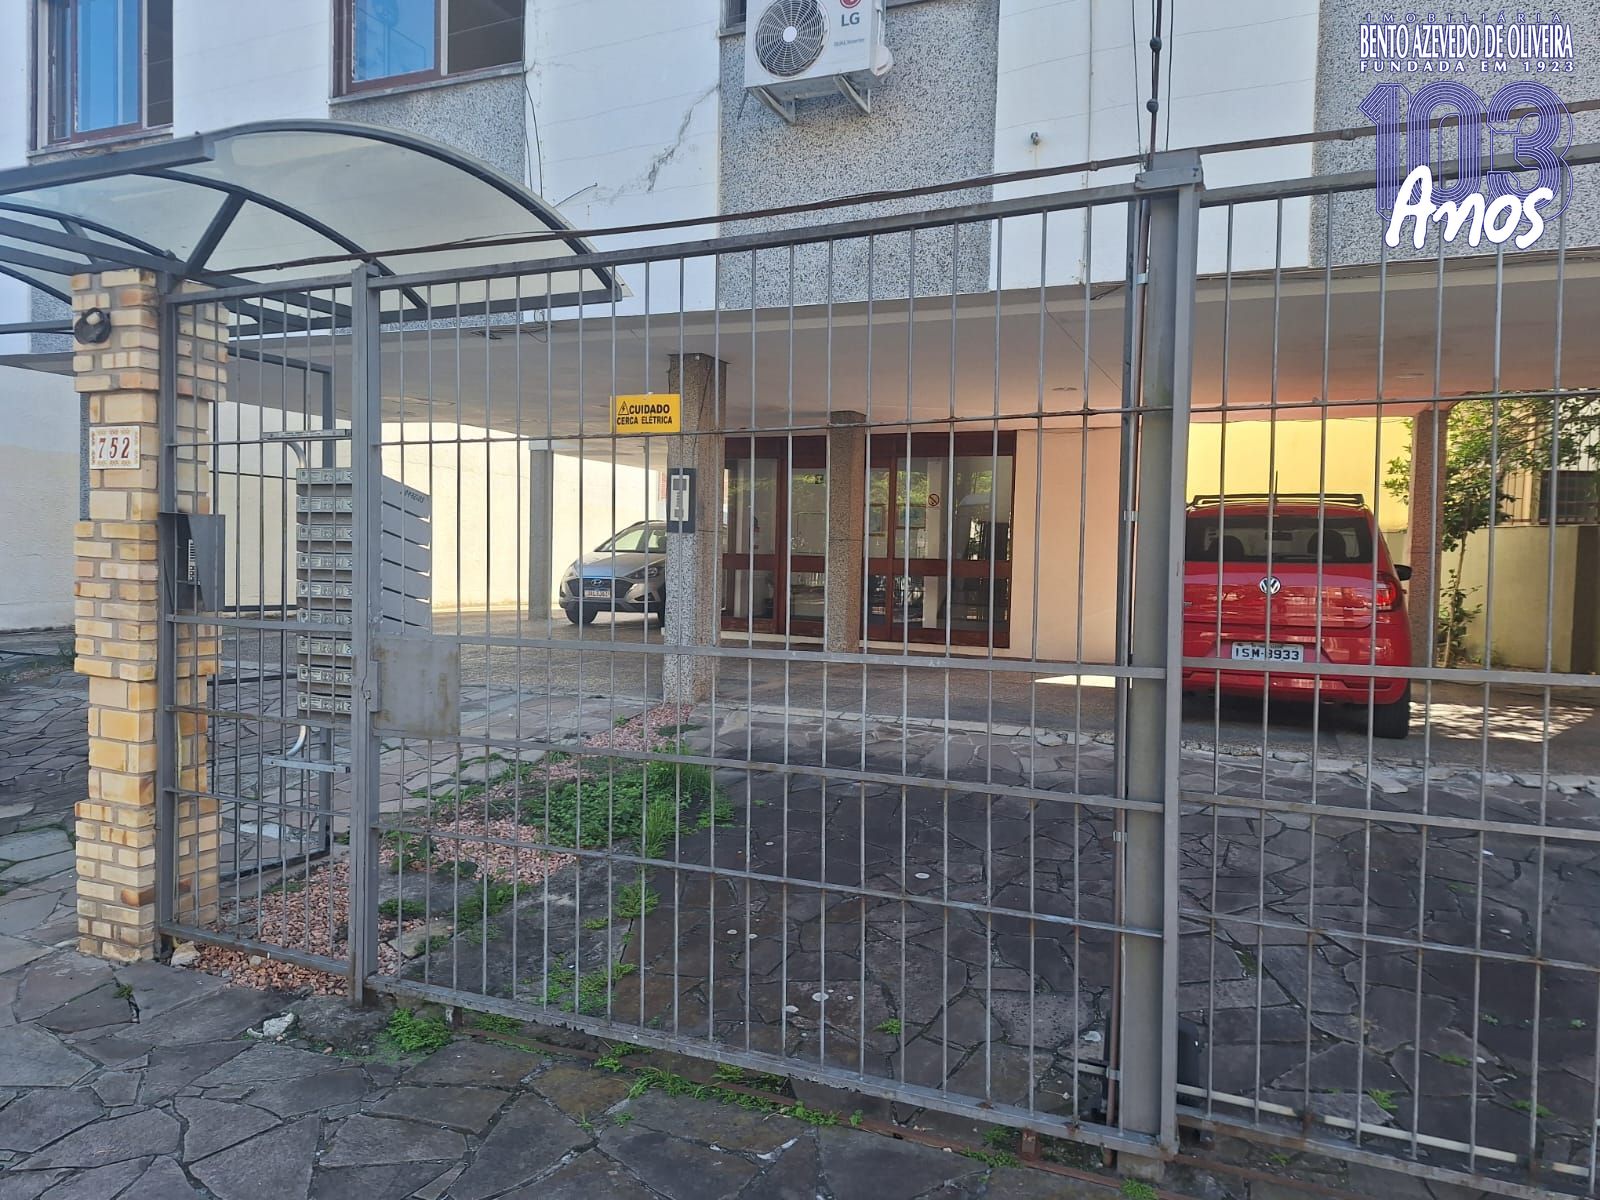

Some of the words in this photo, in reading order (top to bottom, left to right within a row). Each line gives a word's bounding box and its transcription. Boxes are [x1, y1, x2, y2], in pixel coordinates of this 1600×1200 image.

[841, 12, 860, 27] LG
[629, 404, 670, 415] CUIDADO
[616, 416, 639, 426] CERCA
[98, 437, 131, 459] 752
